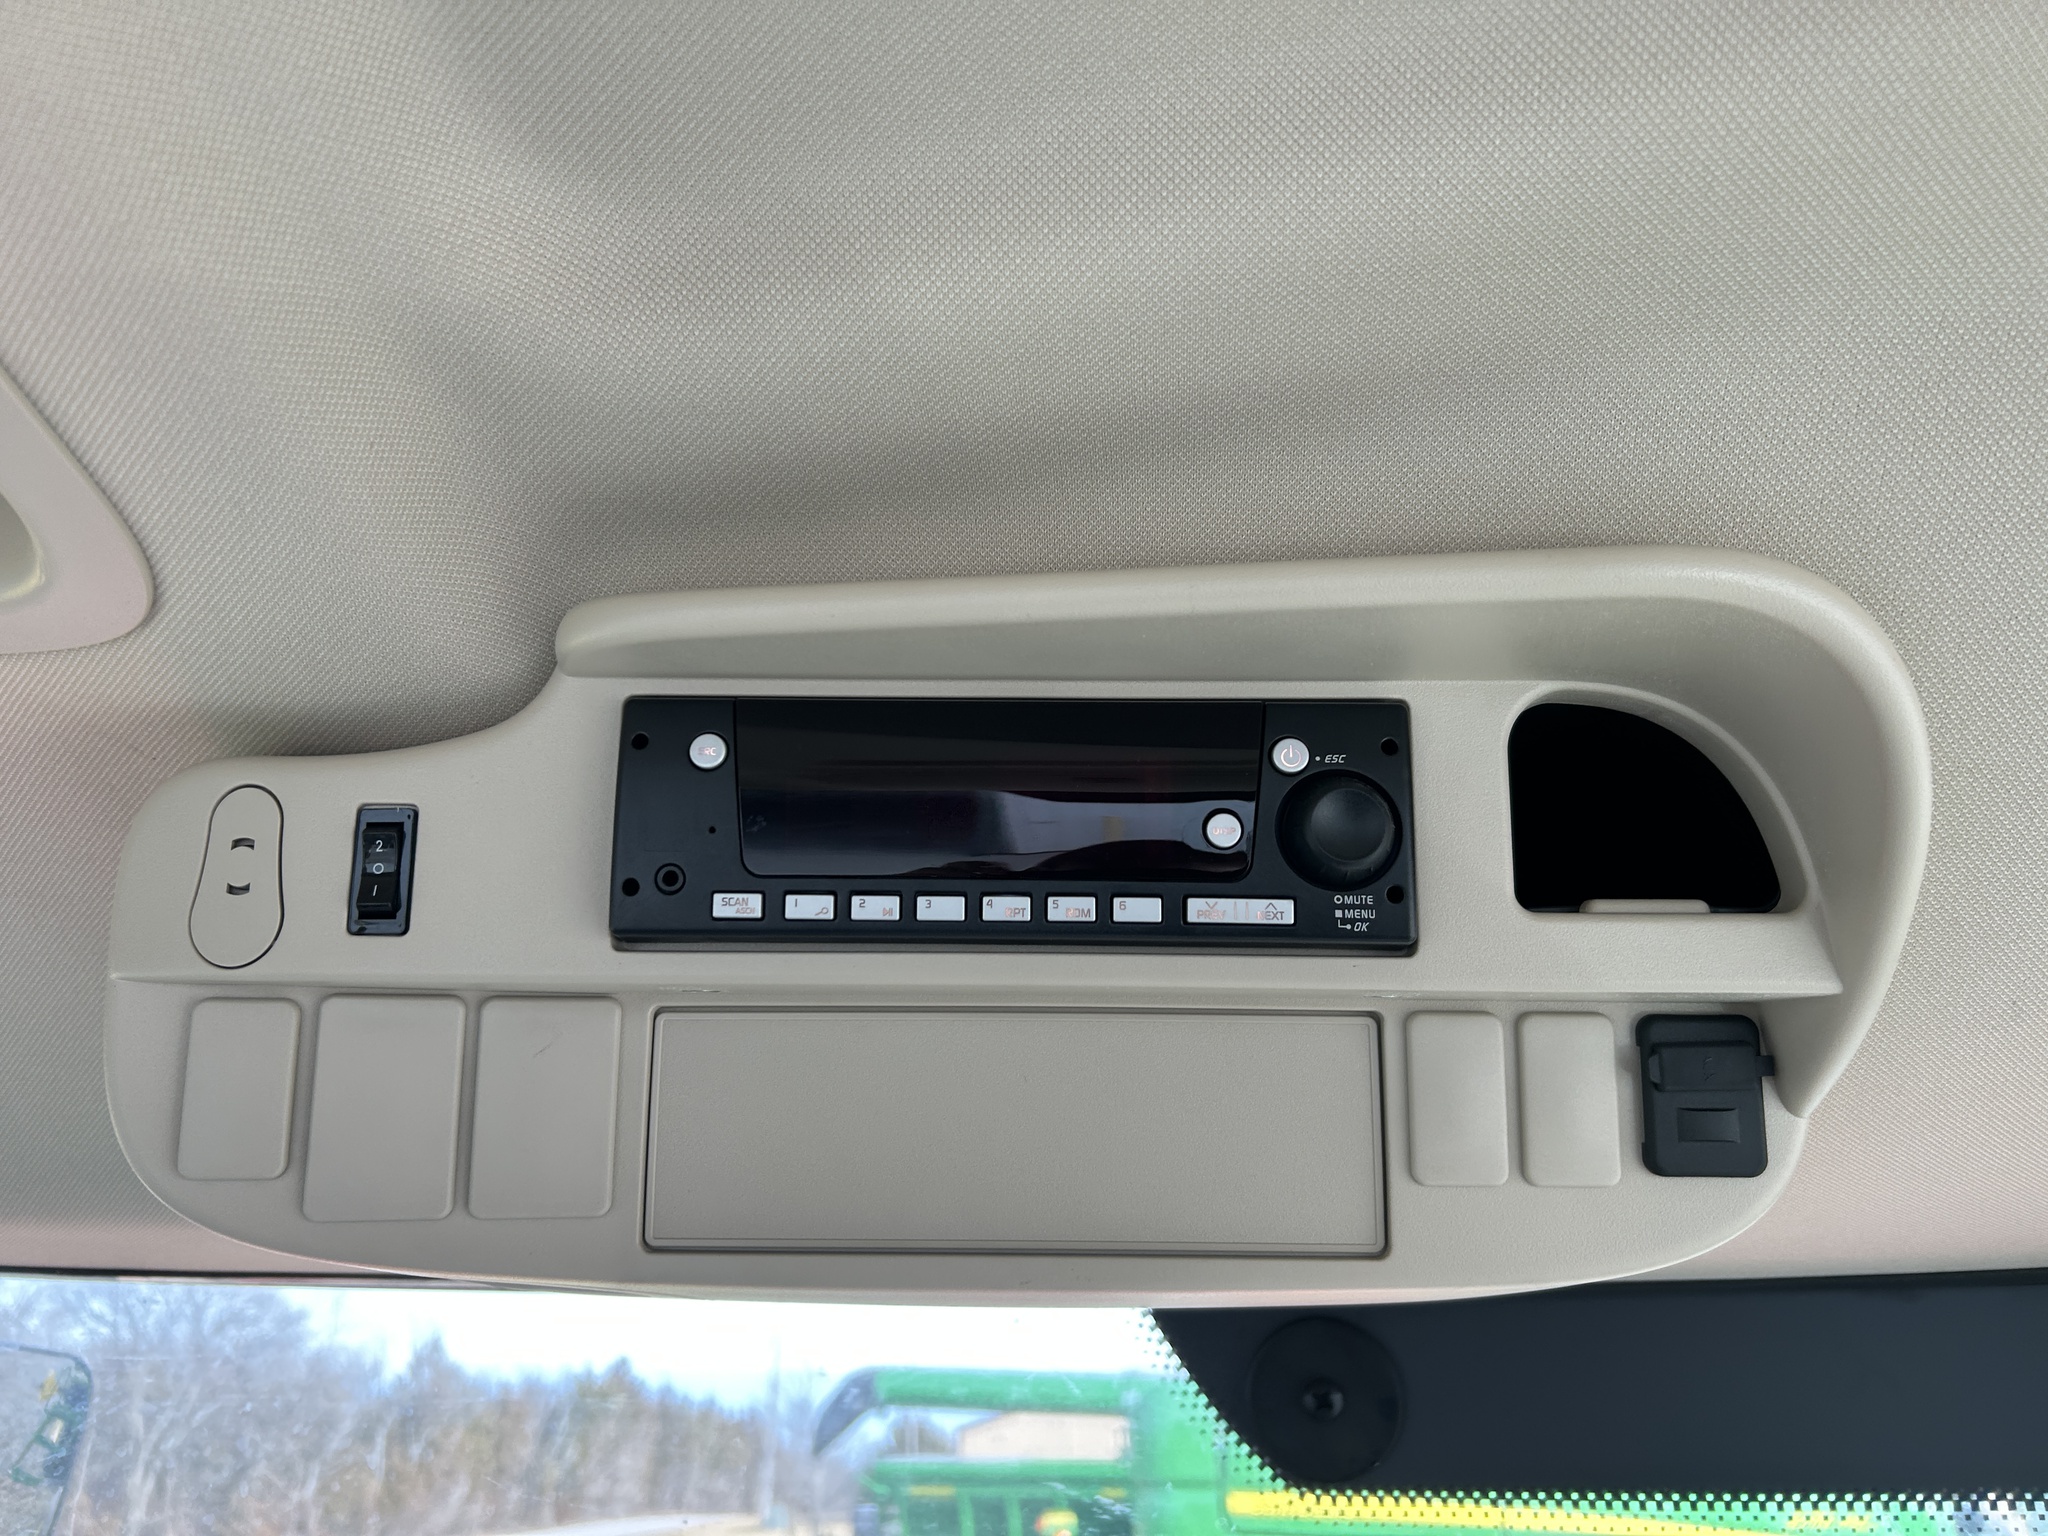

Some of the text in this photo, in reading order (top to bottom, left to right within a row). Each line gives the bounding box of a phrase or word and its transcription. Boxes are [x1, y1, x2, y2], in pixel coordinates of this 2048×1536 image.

[1325, 754, 1346, 763] ESC
[375, 839, 384, 852] 2
[721, 896, 749, 907] SCAN
[858, 898, 866, 908] 2
[924, 899, 932, 909] 3
[986, 898, 993, 909] 4
[1052, 899, 1059, 909] 5
[1119, 900, 1127, 910] 6
[1344, 894, 1374, 905] MUTE
[1005, 907, 1026, 918] RPT
[1065, 907, 1091, 918] RDM
[1196, 909, 1227, 920] PREV
[1257, 910, 1285, 921] NEXT
[1344, 908, 1376, 919] MENU
[1353, 921, 1370, 932] OK
